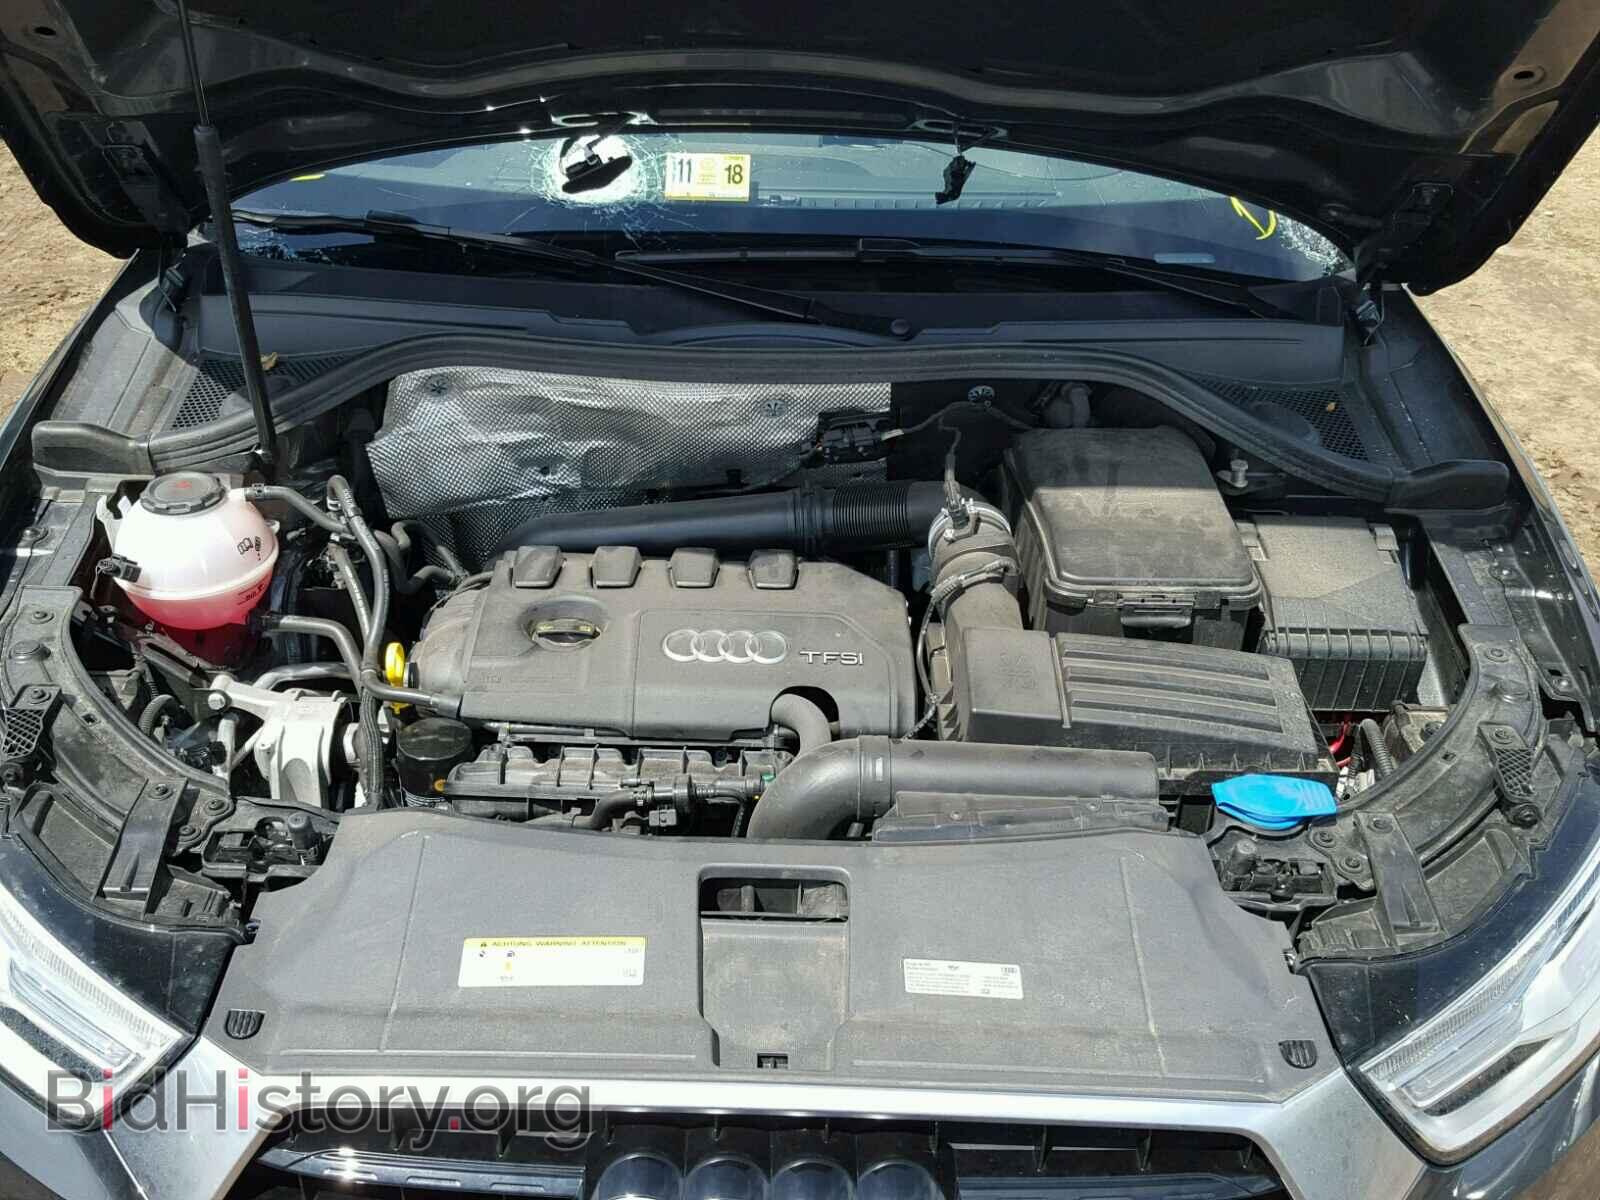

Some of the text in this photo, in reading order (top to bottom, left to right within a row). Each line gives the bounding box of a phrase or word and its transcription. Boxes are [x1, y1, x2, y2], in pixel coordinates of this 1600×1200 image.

[678, 158, 692, 184] 11
[724, 164, 744, 185] 18
[799, 650, 864, 666] TFSI
